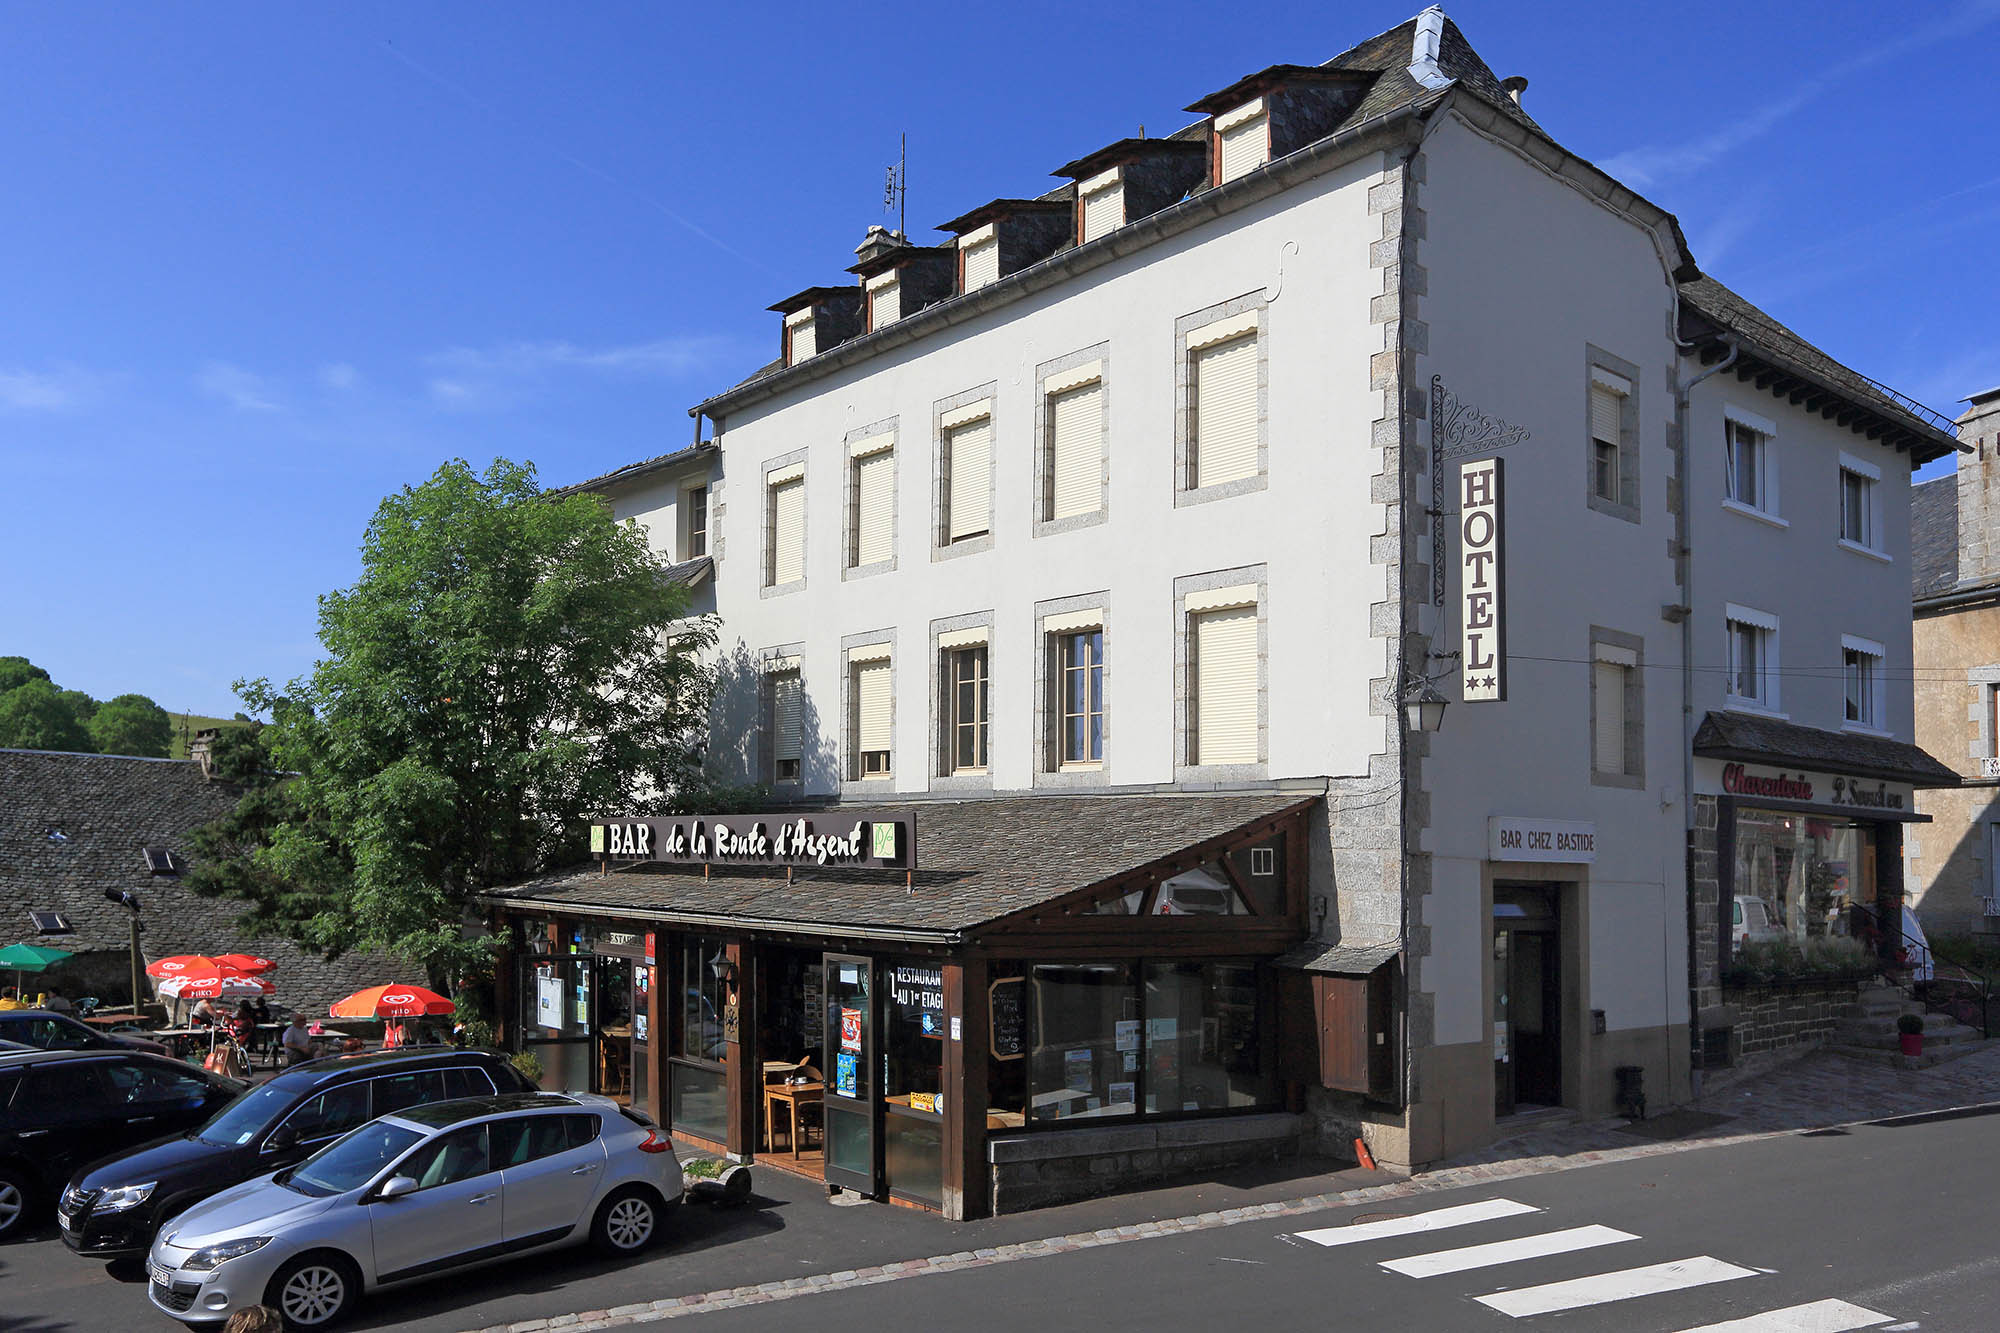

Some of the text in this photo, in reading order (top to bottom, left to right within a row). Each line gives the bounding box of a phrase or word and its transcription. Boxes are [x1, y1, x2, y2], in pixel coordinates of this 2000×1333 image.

[1463, 469, 1494, 670] HOTEL
[1723, 763, 1814, 800] Charcuterie
[609, 823, 650, 854] BAR
[666, 824, 684, 853] de
[690, 820, 706, 854] la
[714, 822, 766, 857] Route
[774, 818, 863, 865] d'Argent
[1501, 830, 1595, 851] BAR CHEZ BASTIDE
[191, 989, 213, 997] MIKO
[897, 988, 908, 1005] AU
